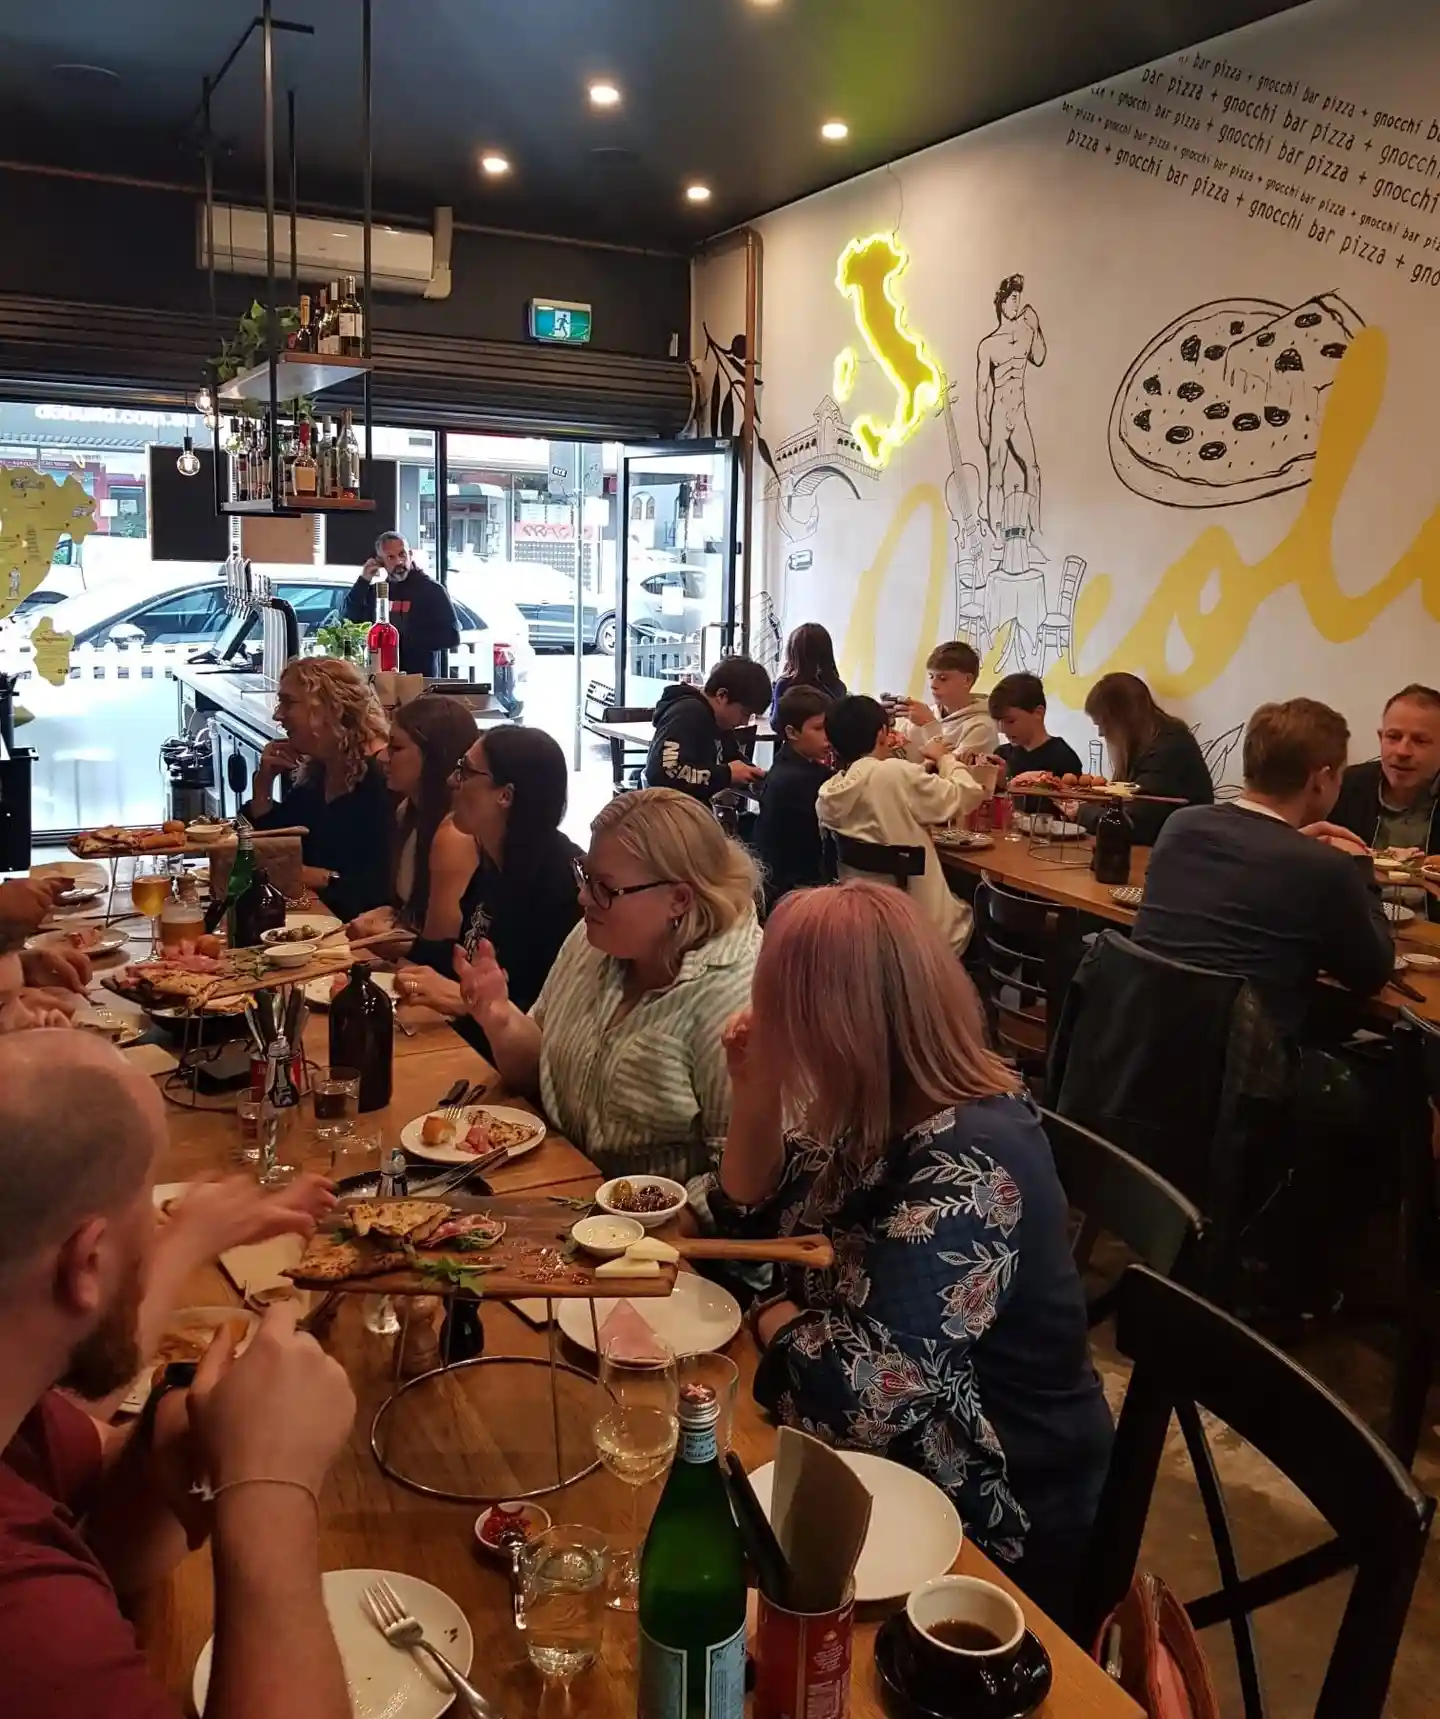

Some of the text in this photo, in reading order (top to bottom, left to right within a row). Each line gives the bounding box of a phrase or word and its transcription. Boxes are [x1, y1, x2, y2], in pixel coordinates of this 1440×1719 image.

[1167, 75, 1204, 100] pizza
[1222, 95, 1278, 124] gnocchi
[1283, 109, 1308, 133] bar
[1310, 122, 1355, 151] pizza
[1193, 51, 1211, 69] bar
[1212, 60, 1242, 81] pizza
[1256, 76, 1300, 97] gnocchi
[1302, 86, 1320, 104] bar
[1322, 96, 1355, 118] pizza
[1373, 111, 1423, 134] gnocchi
[1066, 128, 1099, 153] pizza
[1115, 148, 1163, 177] gnocchi
[1166, 164, 1188, 187] bar
[1191, 175, 1230, 204] pizza
[1248, 199, 1304, 232] gnocchi
[1308, 217, 1335, 244] bar
[1339, 234, 1386, 265] pizza
[1117, 91, 1152, 112] gnocchi
[1154, 103, 1172, 120] bar
[1172, 111, 1201, 131] pizza
[1217, 124, 1274, 155] gnocchi
[1277, 140, 1304, 165] bar
[1304, 154, 1349, 182] pizza
[1372, 178, 1440, 214] gnocchi
[1148, 134, 1171, 151] pizza
[1180, 147, 1211, 165] gnocchi
[1213, 157, 1228, 171] bar
[1229, 164, 1254, 182] pizza
[1265, 178, 1300, 199] gnocchi
[1300, 191, 1316, 205] bar
[1318, 198, 1346, 217] pizza
[1360, 214, 1400, 235] gnocchi
[1402, 227, 1420, 243] bar
[677, 764, 711, 786] AIR
